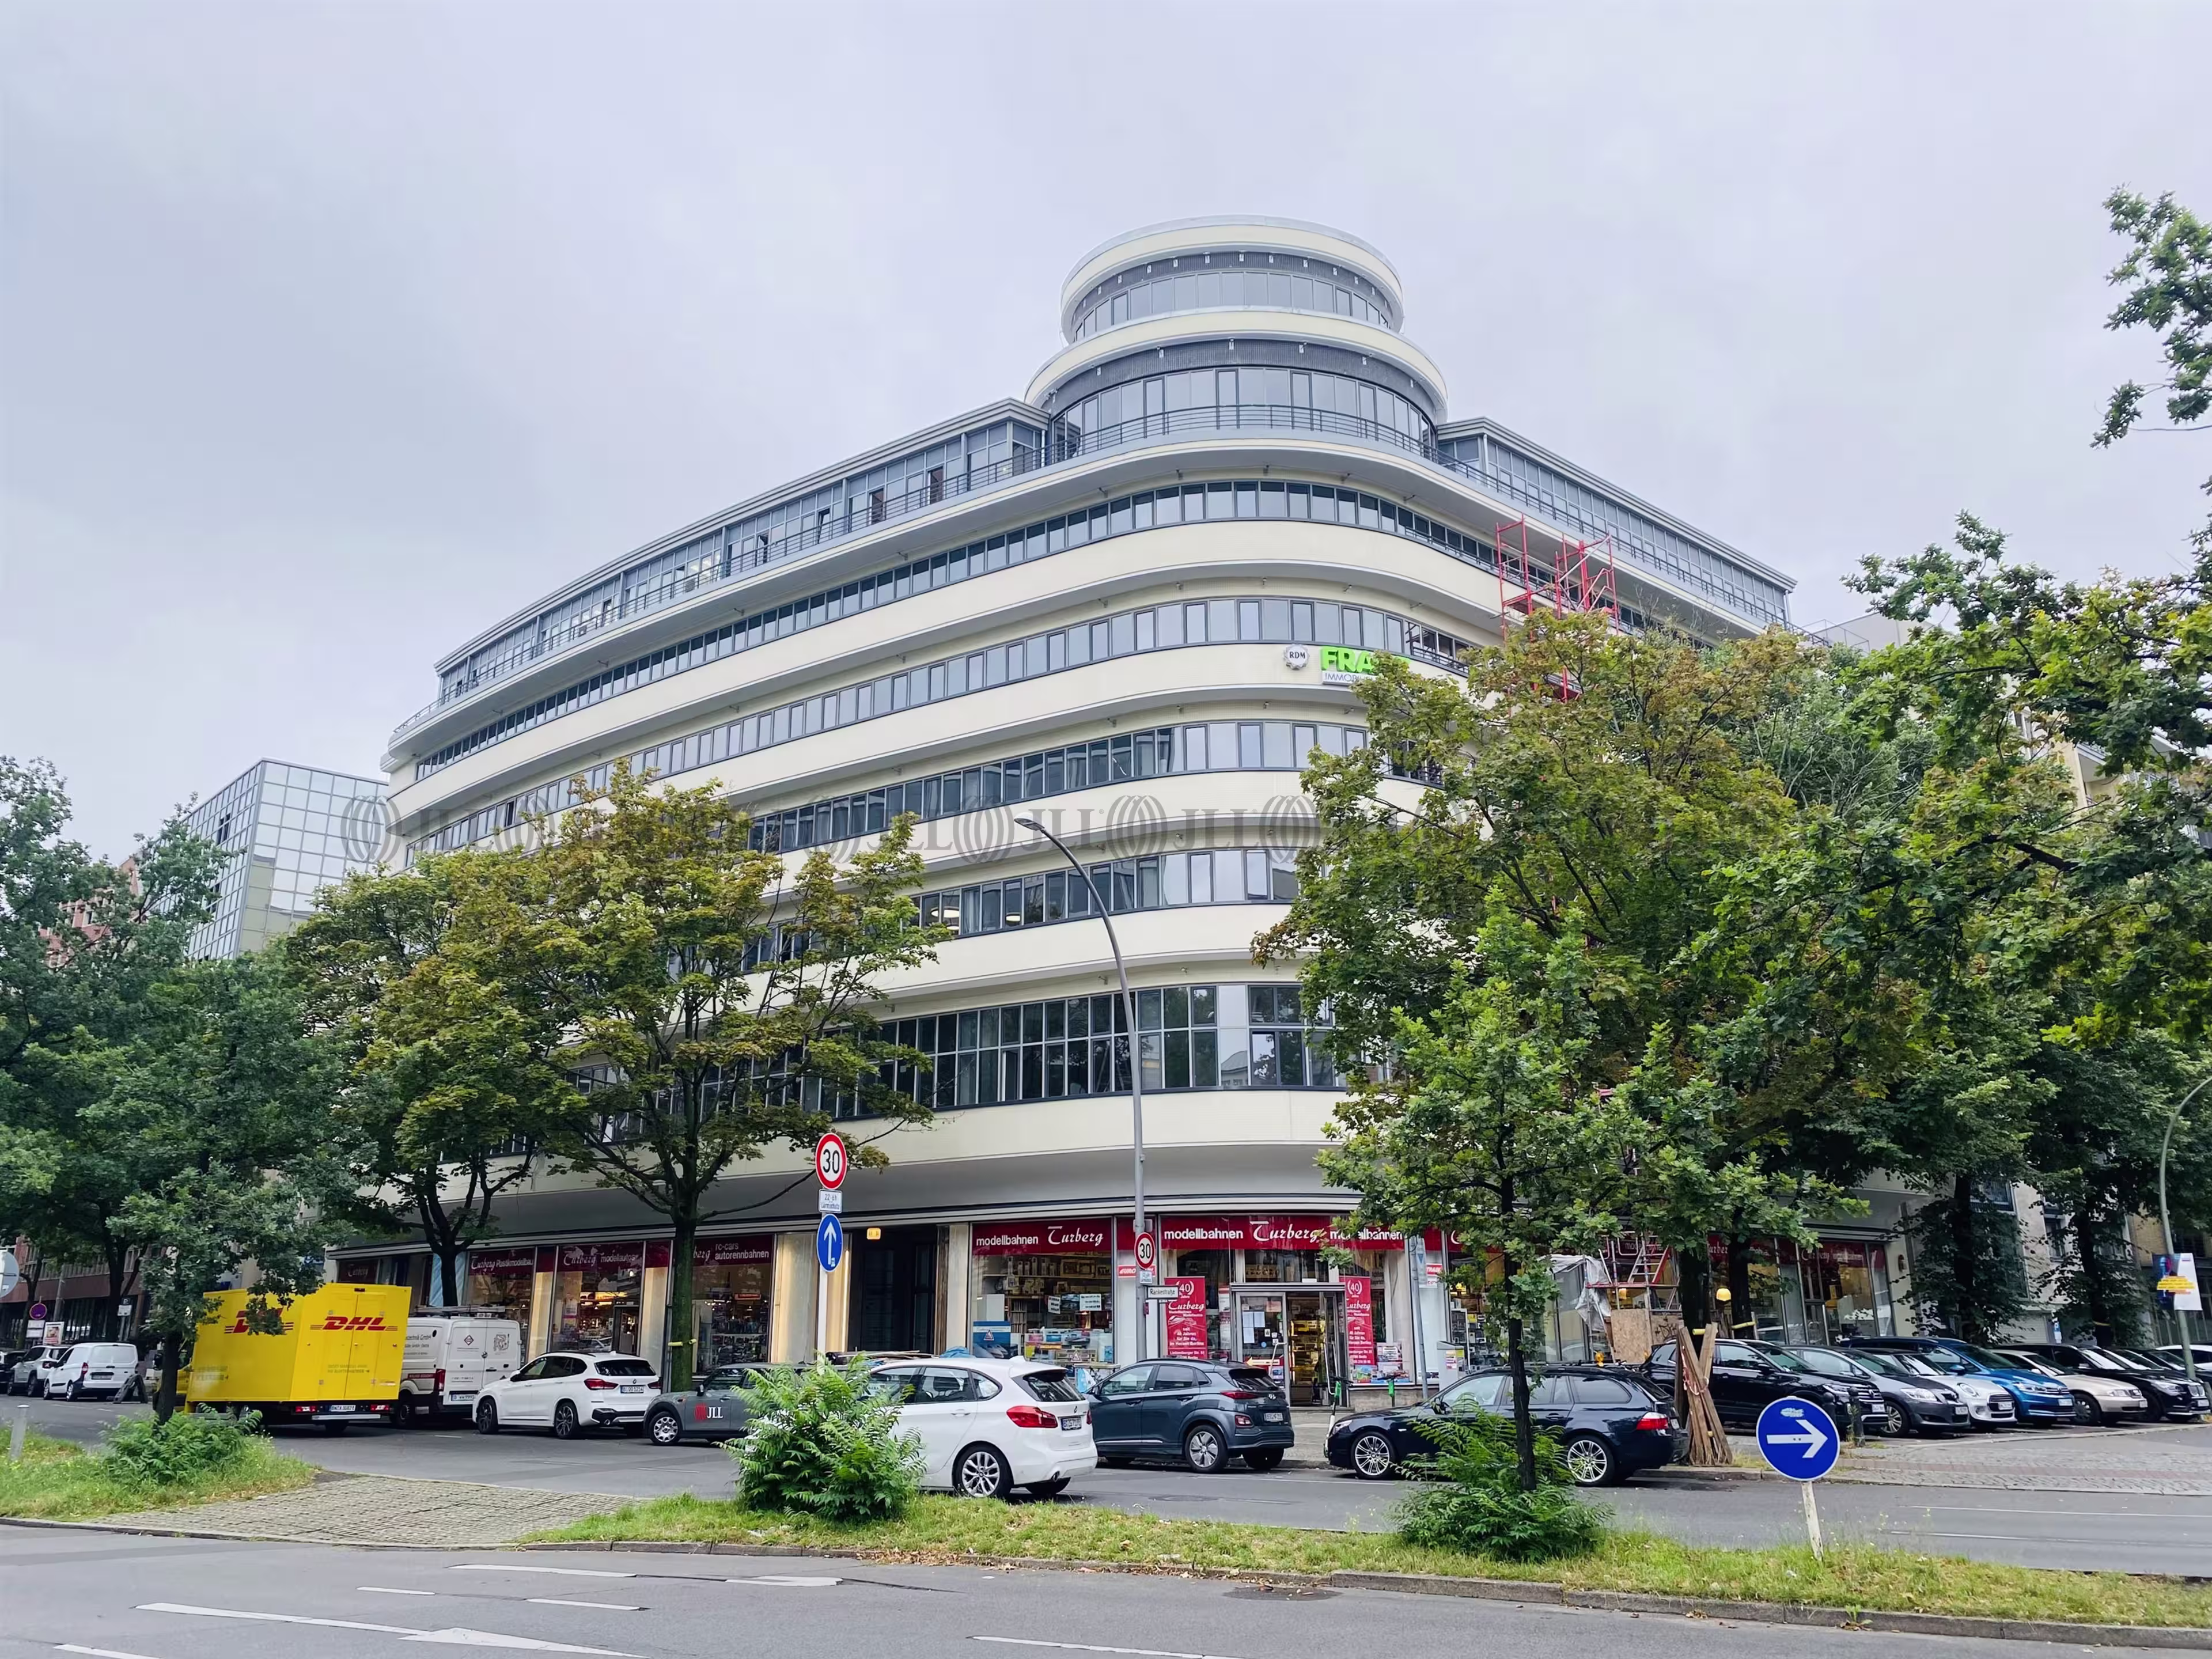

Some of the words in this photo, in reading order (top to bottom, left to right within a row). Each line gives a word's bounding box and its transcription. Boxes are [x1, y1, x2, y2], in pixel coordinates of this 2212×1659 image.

[823, 1149, 840, 1174] 30
[976, 1234, 1038, 1246] modellbahnen
[1047, 1226, 1103, 1246] Turberg
[1164, 1228, 1244, 1239] modellbahnen
[1249, 1221, 1320, 1243] Turberg
[1330, 1227, 1403, 1240] moellbahnen
[715, 1250, 769, 1260] autorennbahnen
[1139, 1243, 1151, 1259] 30
[1179, 1284, 1191, 1293] 40
[1350, 1283, 1359, 1291] 40
[1168, 1300, 1205, 1312] Turberg
[323, 1316, 386, 1331] DHL
[707, 1407, 724, 1418] JLL
